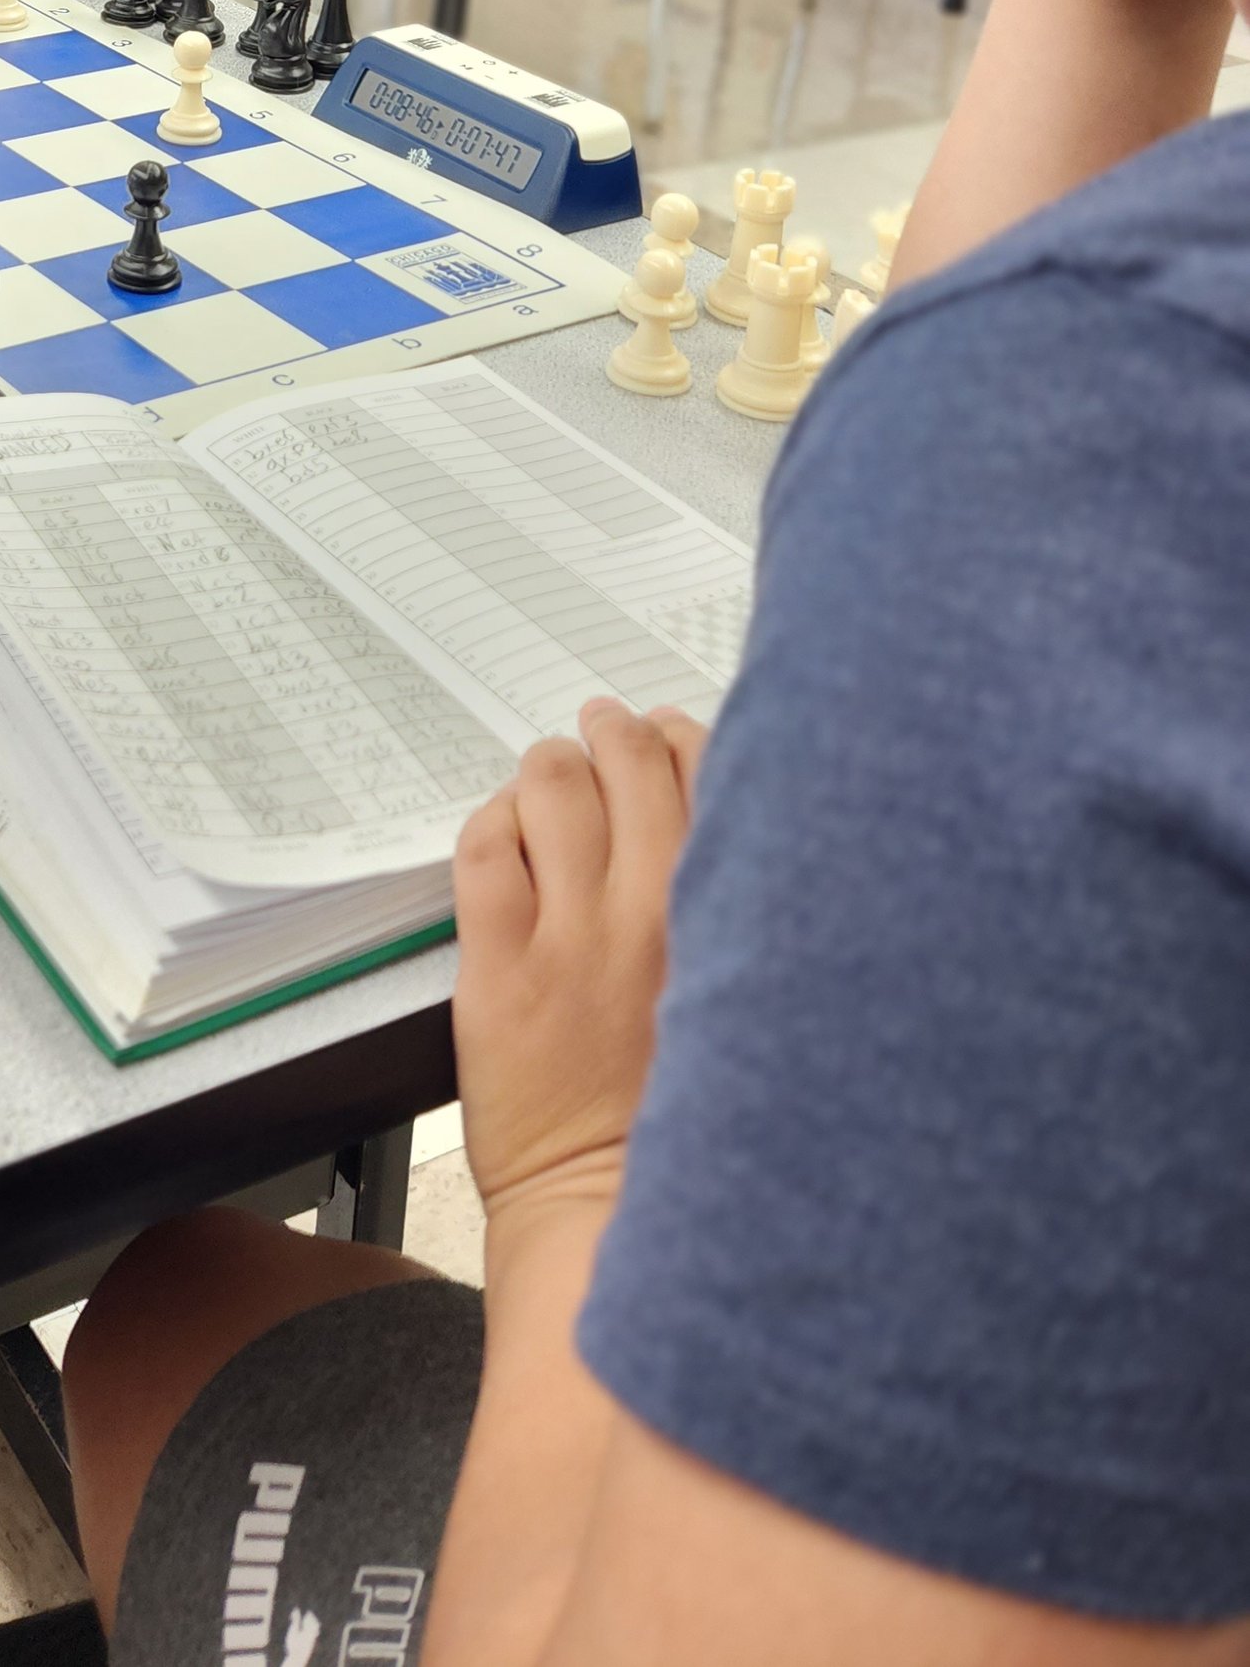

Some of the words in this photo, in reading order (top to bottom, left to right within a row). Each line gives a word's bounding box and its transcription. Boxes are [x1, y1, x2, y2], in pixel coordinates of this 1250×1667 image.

[49, 7, 70, 16] 2
[112, 39, 133, 48] 3
[249, 109, 273, 121] 5
[369, 81, 440, 135] 0:08:46
[444, 117, 522, 174] 0:07:47
[333, 152, 357, 163] 6
[420, 194, 448, 206] 7
[389, 244, 452, 266] CHICAGO
[516, 243, 543, 258] 8
[271, 374, 295, 386] c
[391, 336, 422, 350] b
[512, 303, 539, 317] a
